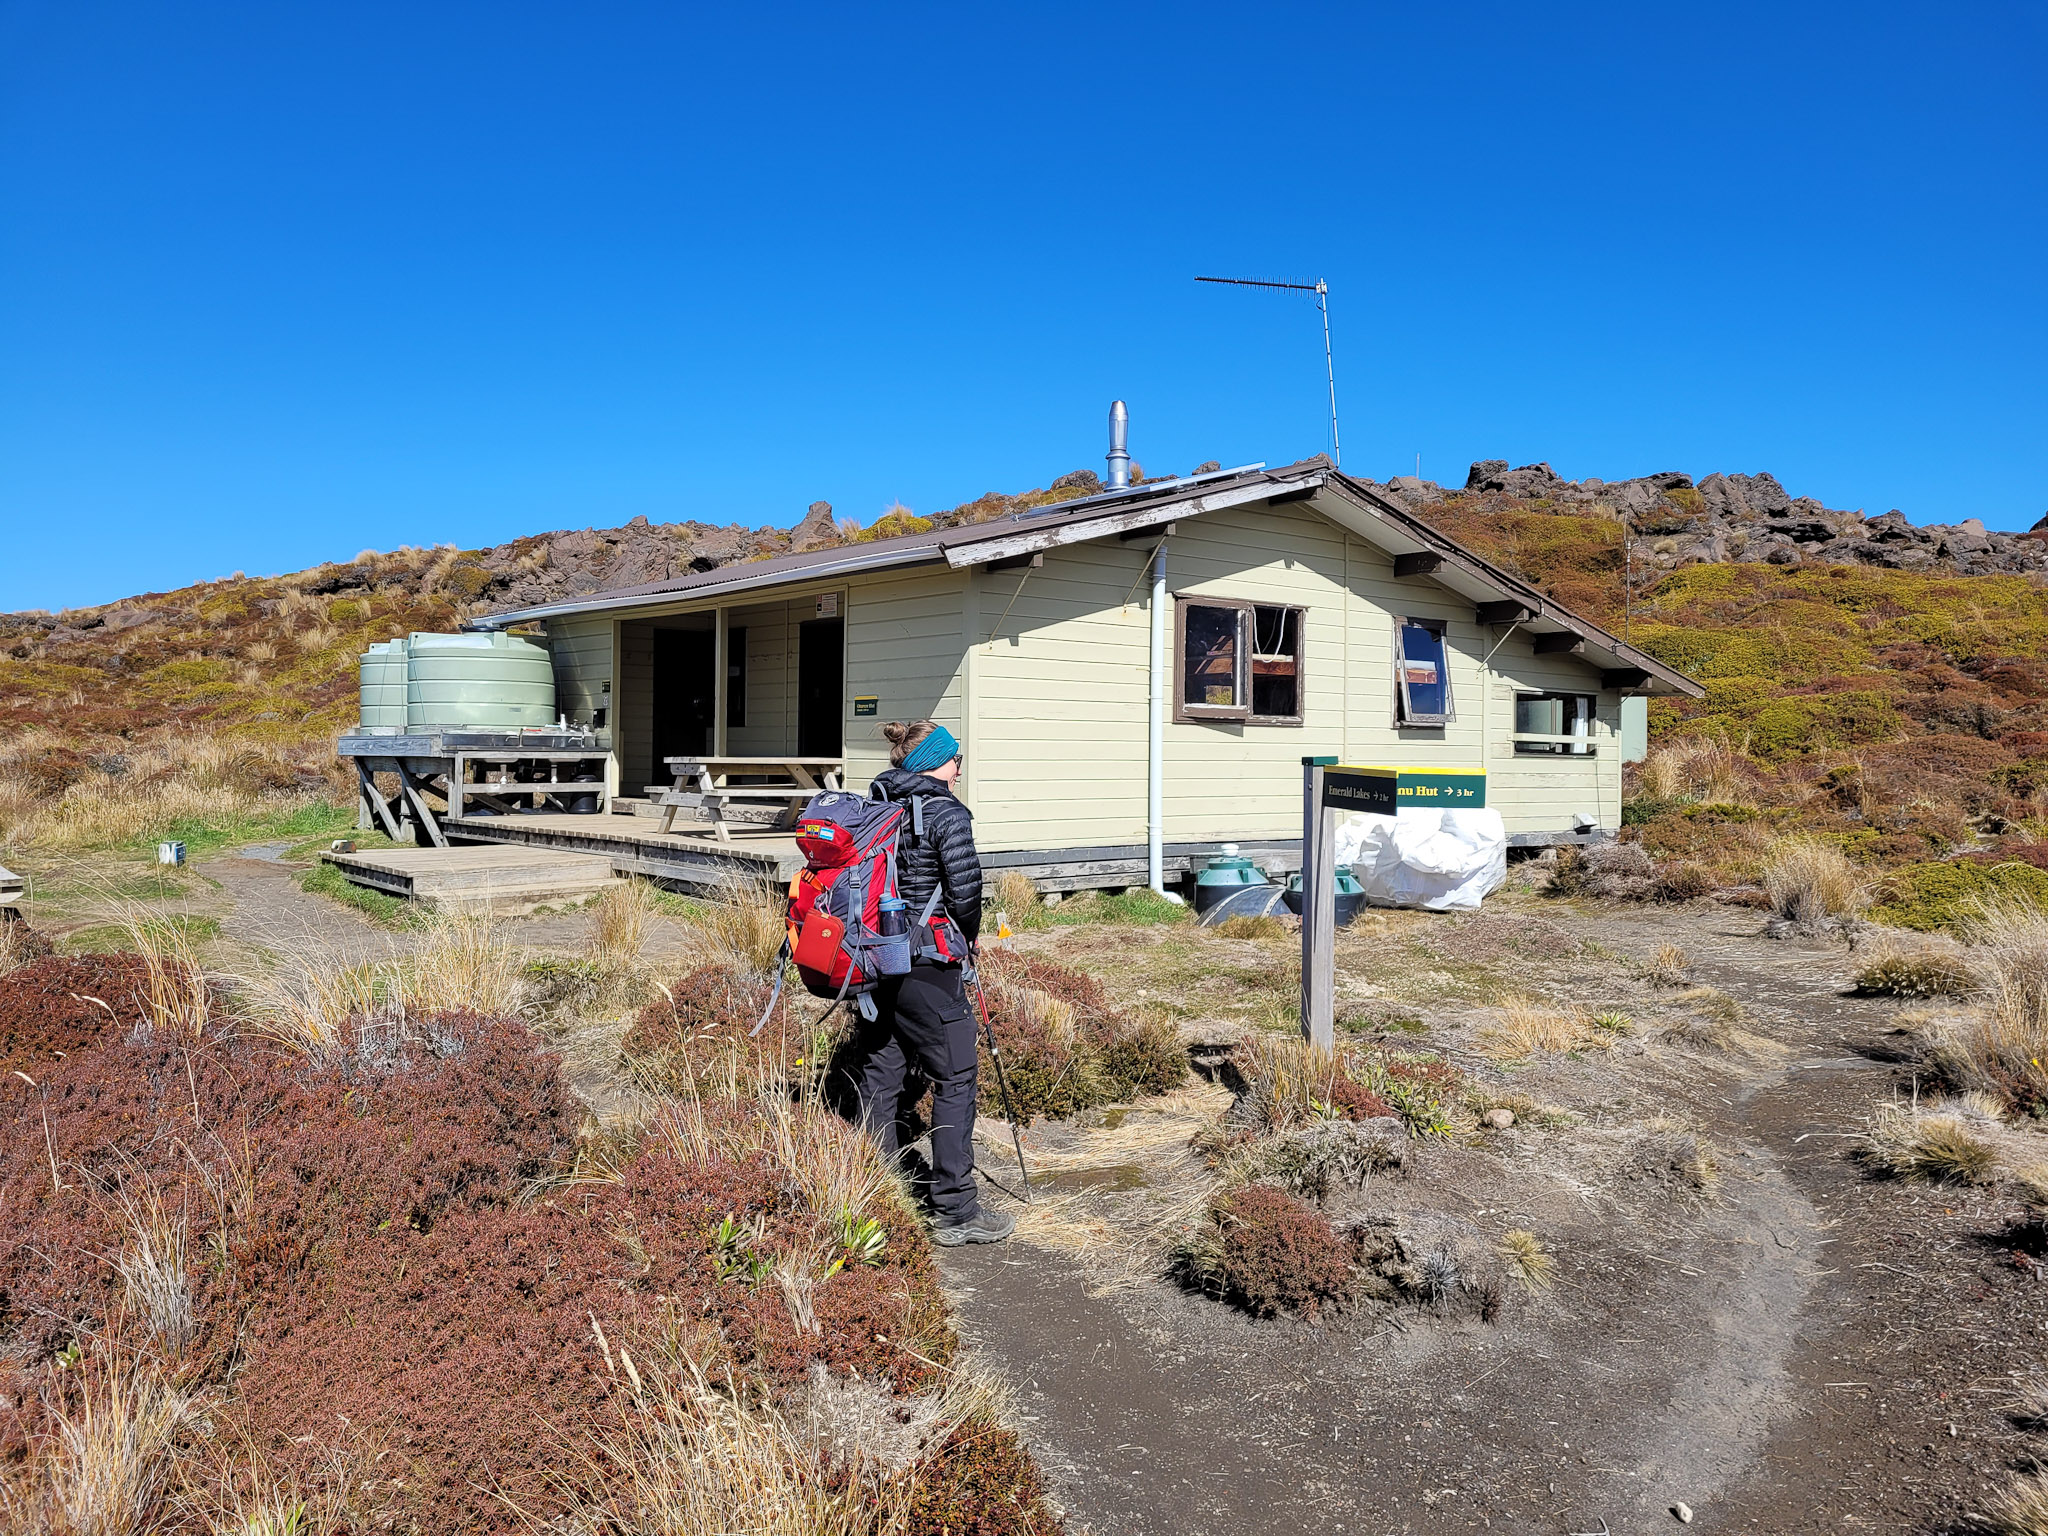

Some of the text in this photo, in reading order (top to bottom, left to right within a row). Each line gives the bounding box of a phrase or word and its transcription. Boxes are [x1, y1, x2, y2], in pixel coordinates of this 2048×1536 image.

[1328, 784, 1352, 798] Emerald
[1353, 787, 1371, 800] Lakes
[1383, 793, 1389, 802] hr
[1415, 785, 1439, 797] Hut
[1456, 788, 1463, 797] 3
[1463, 788, 1475, 797] hr
